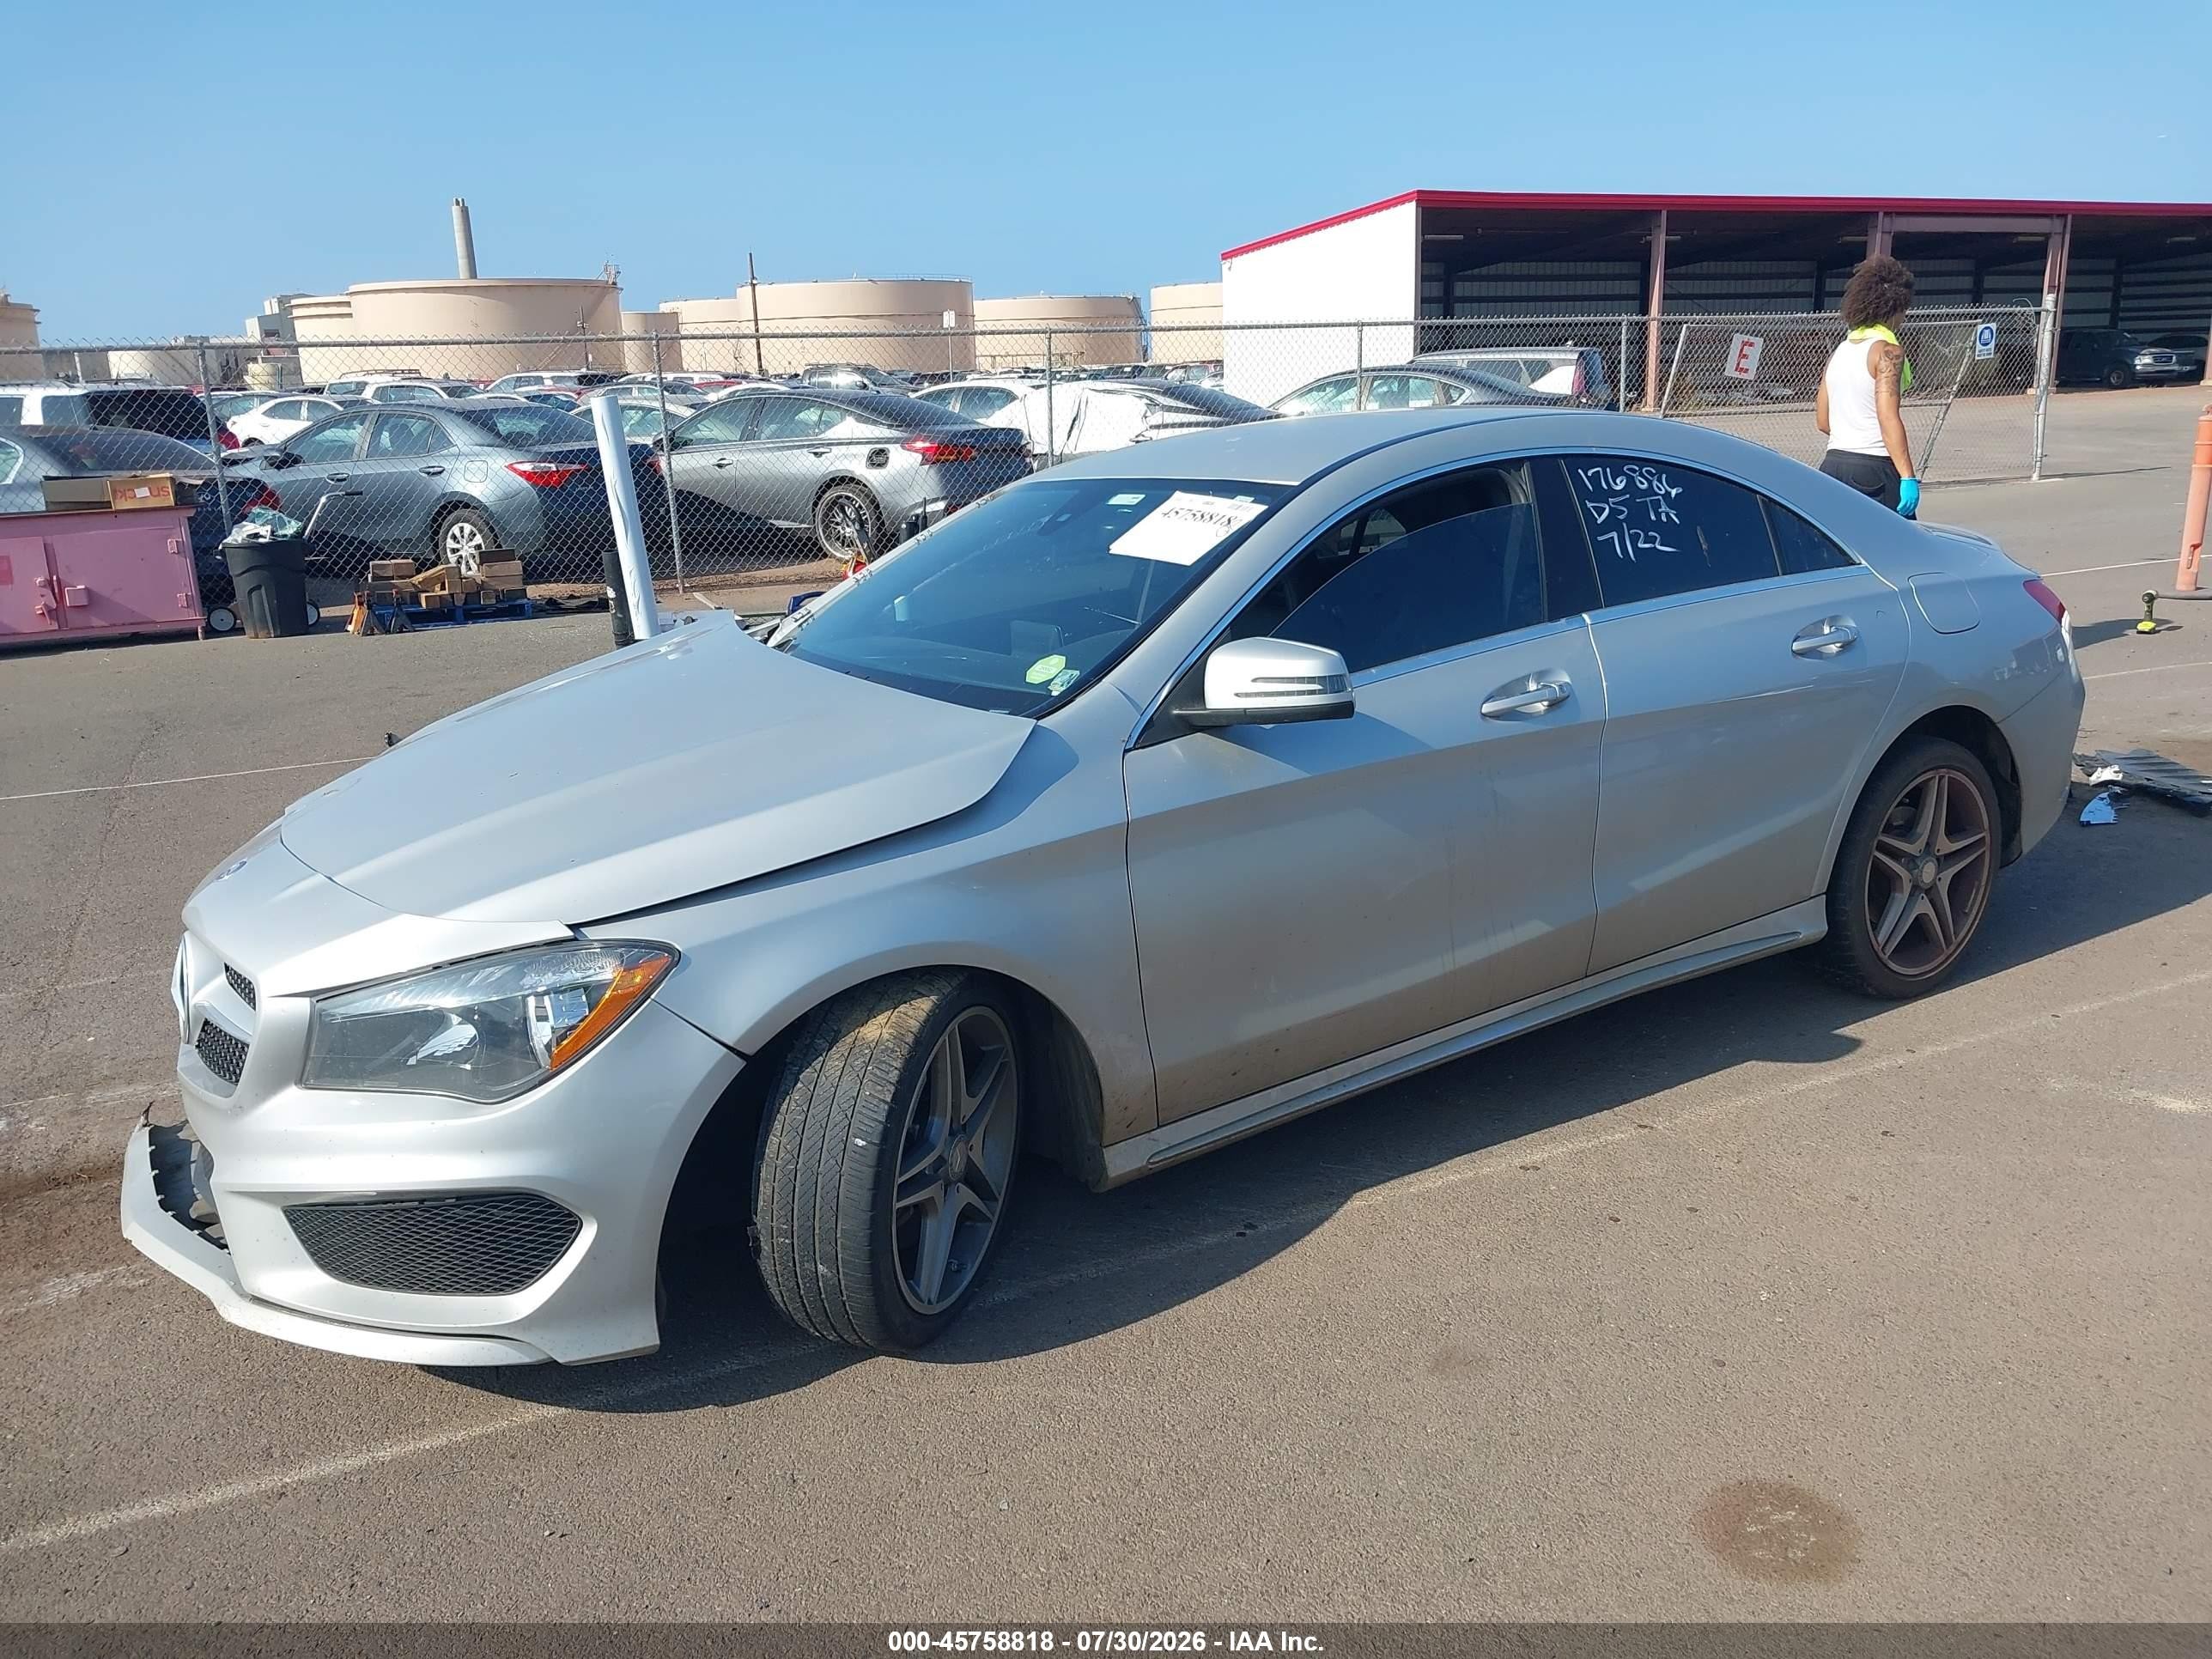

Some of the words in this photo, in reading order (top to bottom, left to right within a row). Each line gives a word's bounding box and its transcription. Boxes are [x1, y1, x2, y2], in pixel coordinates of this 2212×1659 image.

[1734, 340, 1755, 374] E
[1577, 465, 1683, 500] 176886
[1596, 521, 1682, 562] 7/22
